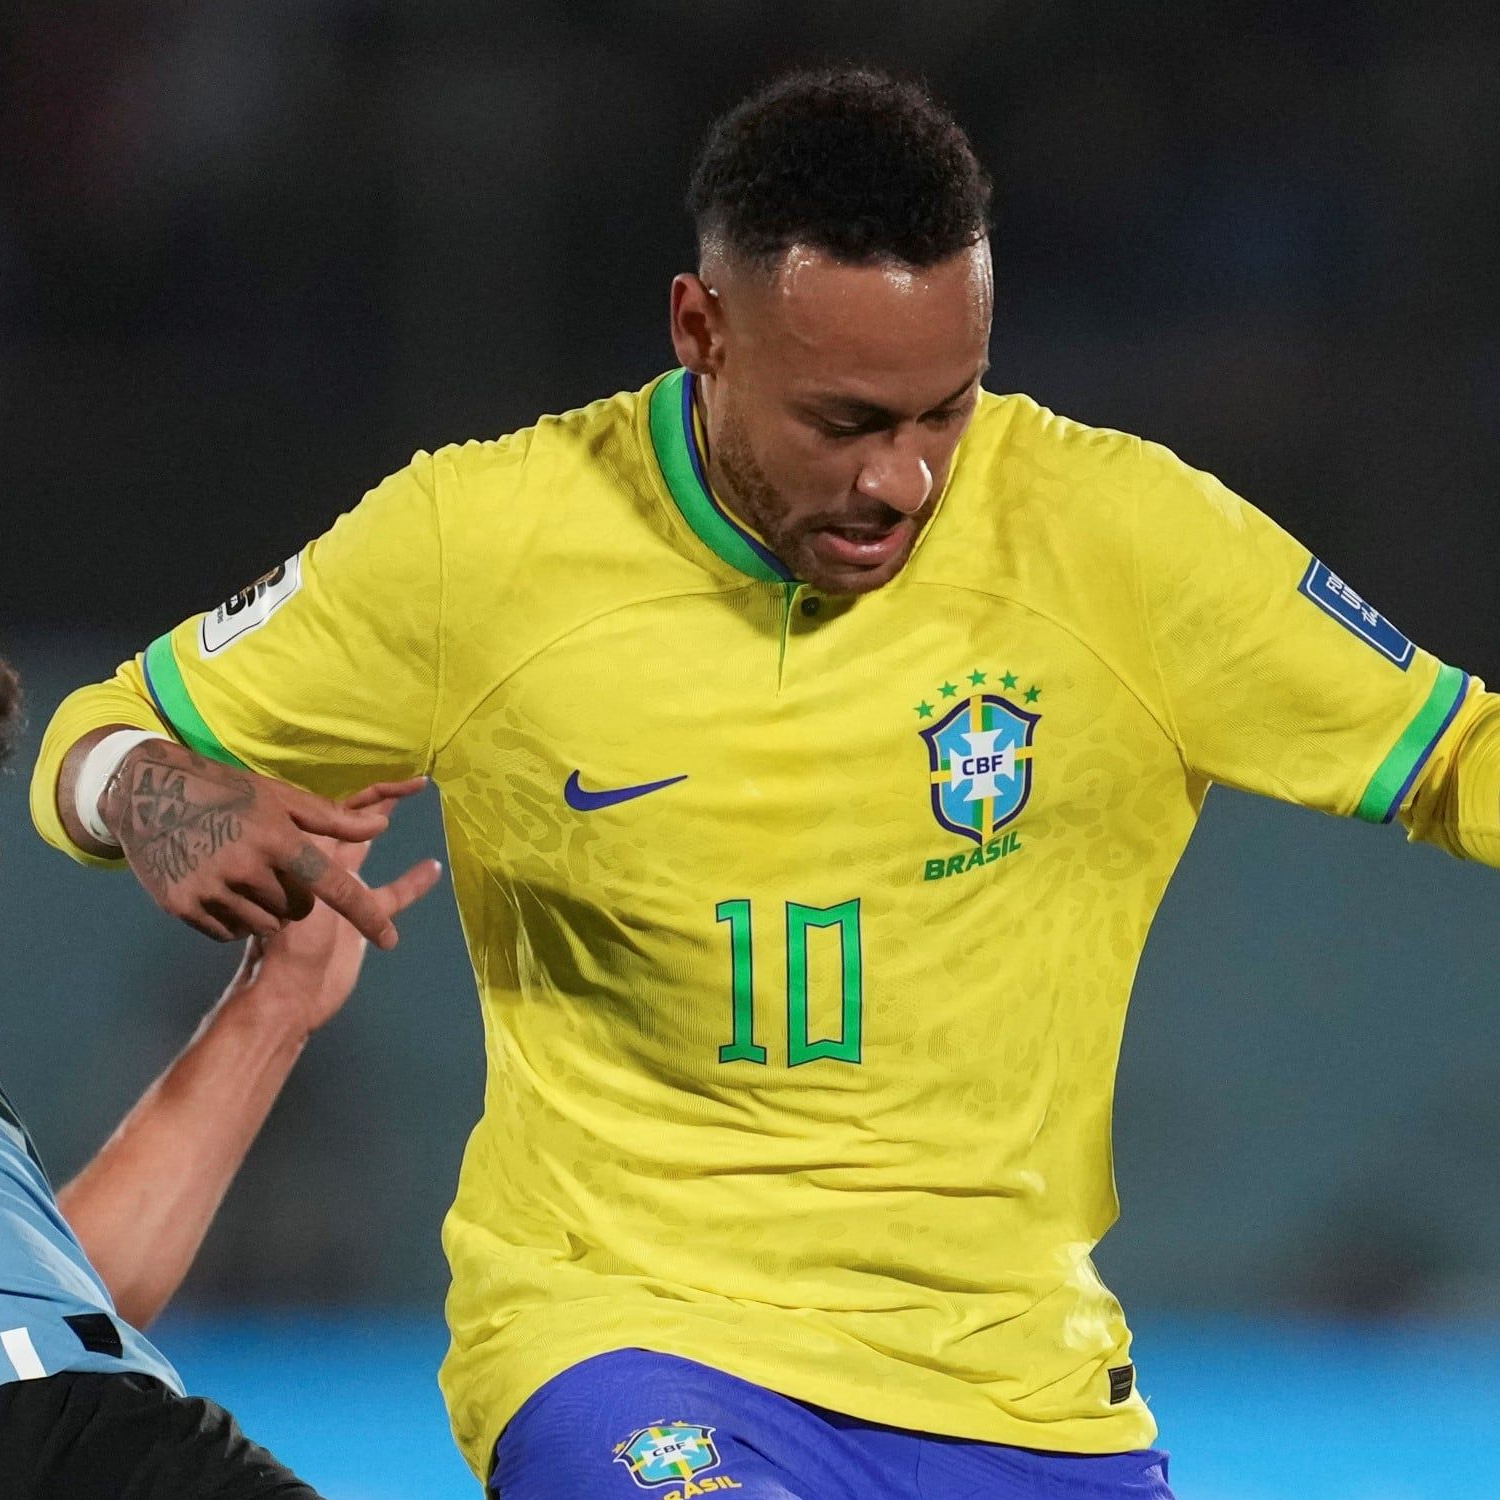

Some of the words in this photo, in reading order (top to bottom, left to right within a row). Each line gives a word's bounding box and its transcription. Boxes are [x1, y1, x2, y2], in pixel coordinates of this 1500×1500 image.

[962, 754, 1004, 776] CBF
[923, 830, 1023, 881] BRASIL
[714, 897, 862, 1068] 10
[652, 1441, 686, 1457] CBF
